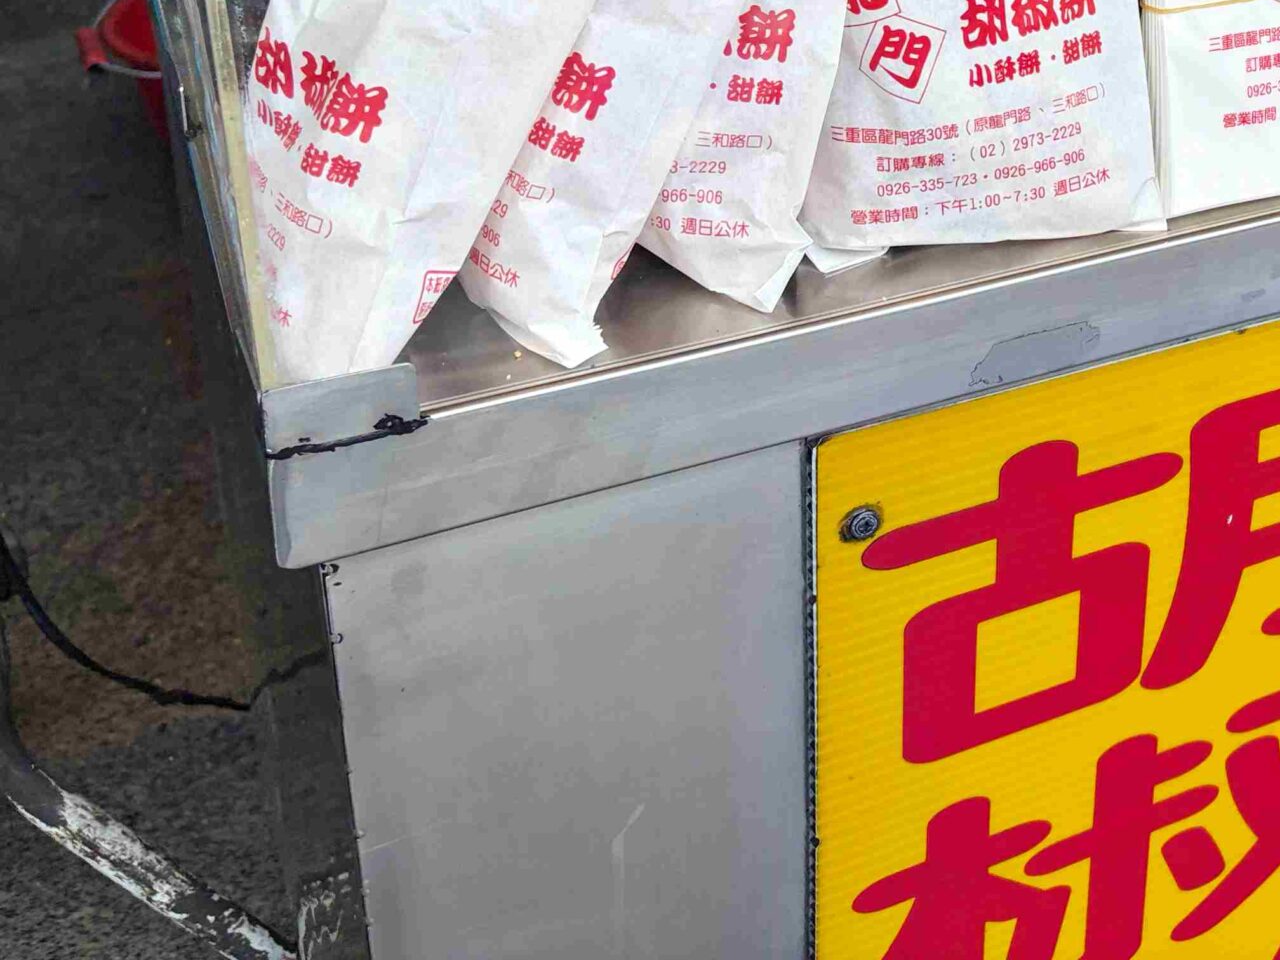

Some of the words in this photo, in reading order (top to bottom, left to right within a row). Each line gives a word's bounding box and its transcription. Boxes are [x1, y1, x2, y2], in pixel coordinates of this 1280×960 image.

[723, 5, 796, 63] 餅
[552, 52, 616, 121] 餅
[528, 117, 585, 162] 甜餅
[680, 217, 750, 238] 週日公休
